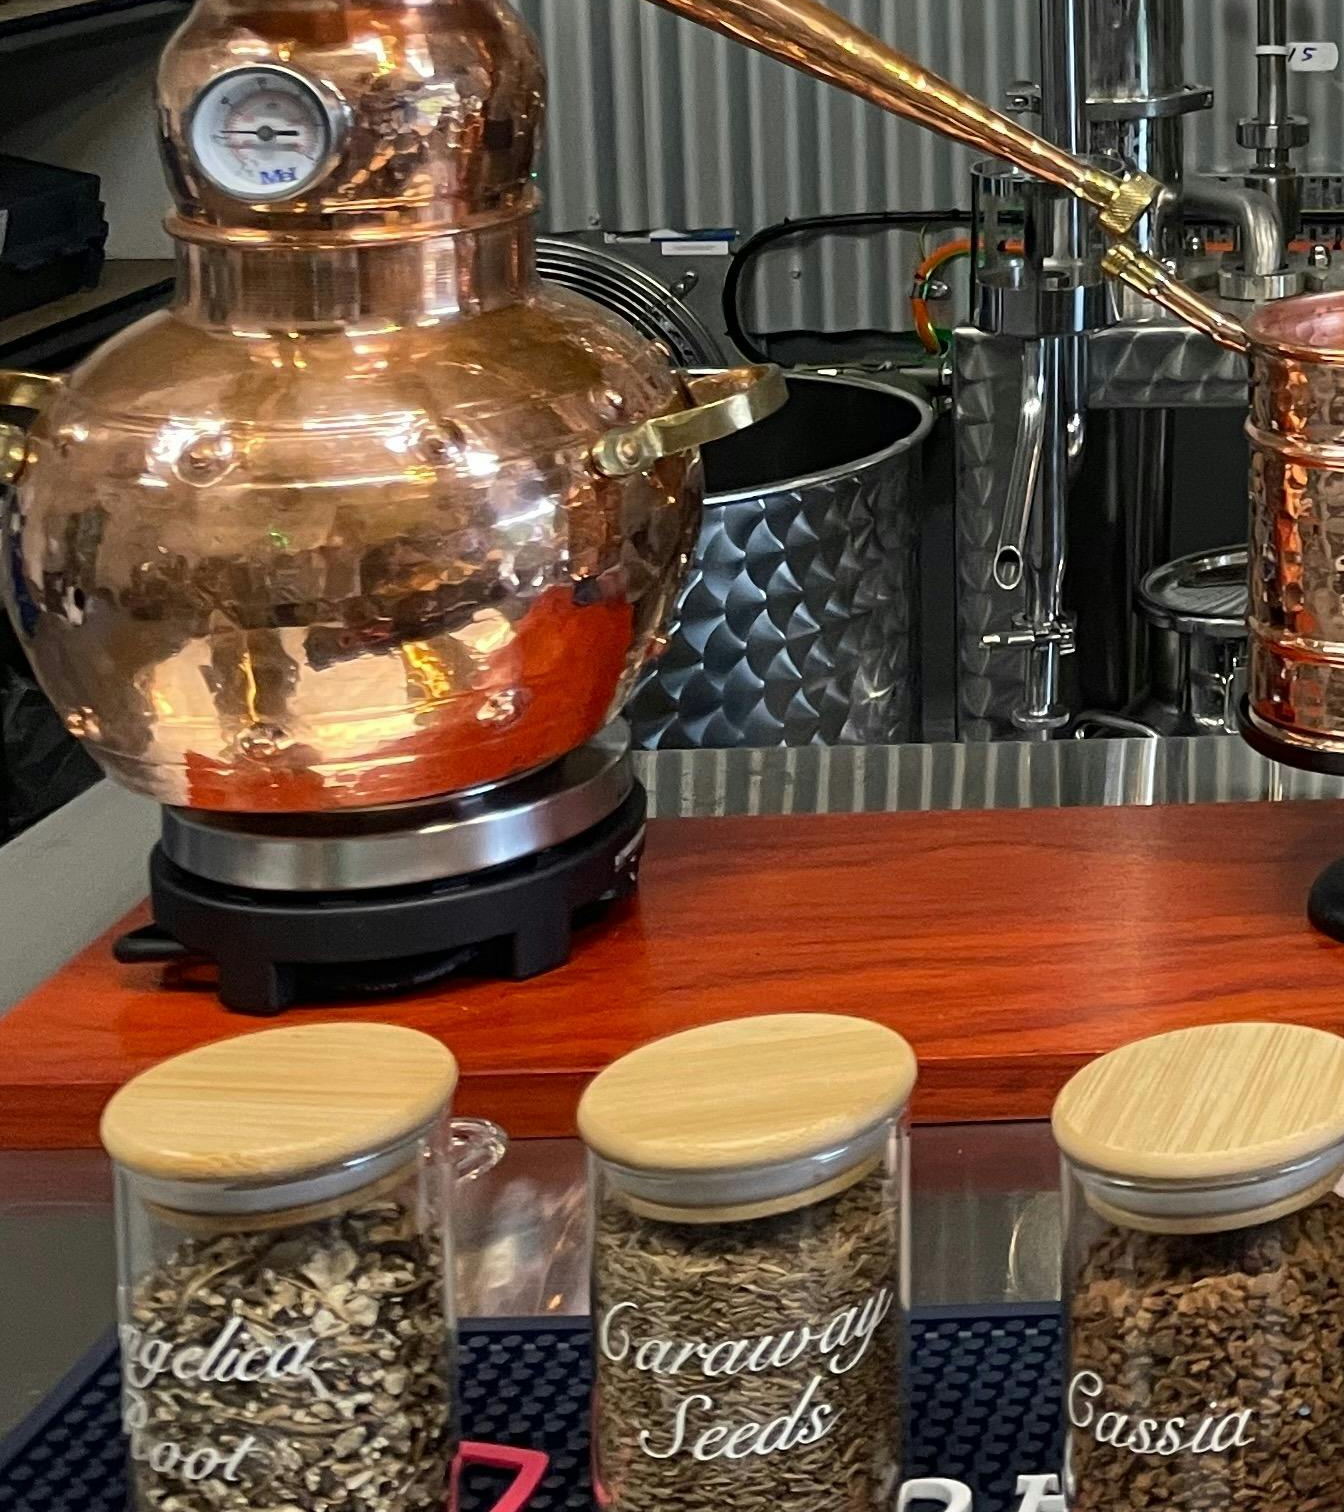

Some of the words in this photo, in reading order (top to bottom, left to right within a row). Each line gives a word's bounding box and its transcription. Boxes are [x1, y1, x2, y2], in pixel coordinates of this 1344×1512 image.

[600, 1288, 894, 1376] Caraway
[636, 1376, 845, 1461] Seeds
[1068, 1370, 1255, 1455] Cassia
